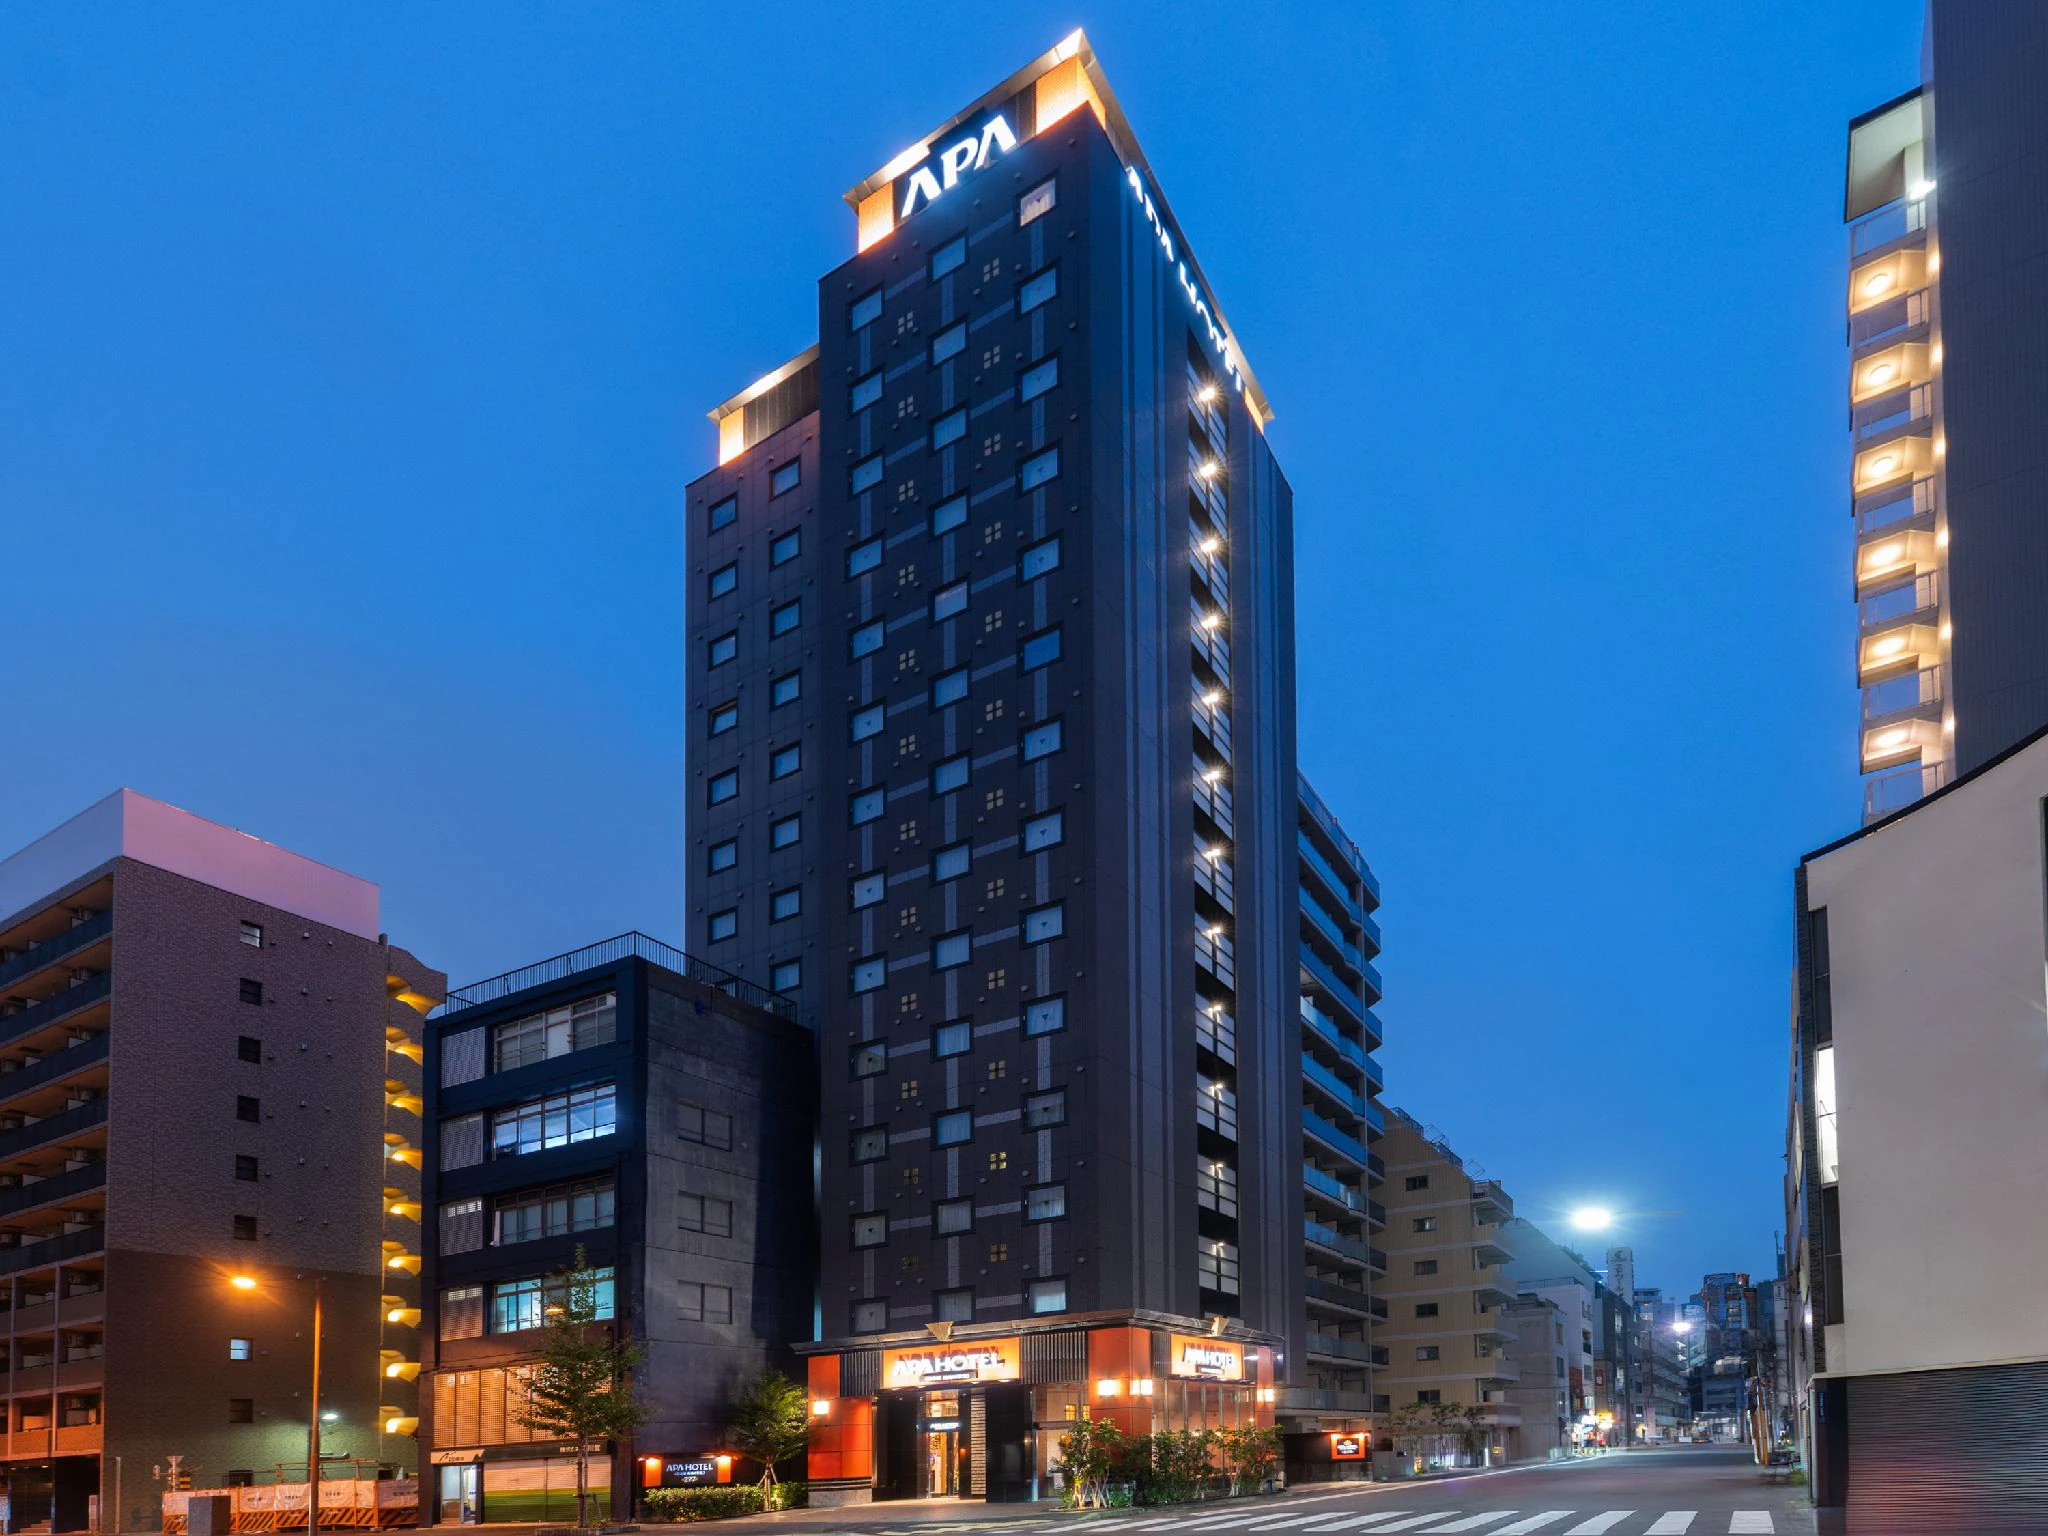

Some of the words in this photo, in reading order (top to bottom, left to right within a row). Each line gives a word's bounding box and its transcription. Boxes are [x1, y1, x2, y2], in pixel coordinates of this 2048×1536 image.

[900, 113, 1018, 218] APA
[893, 1358, 935, 1377] APA
[935, 1351, 1006, 1373] HOTEL
[666, 1464, 684, 1472] APA
[685, 1463, 714, 1471] HOTEL
